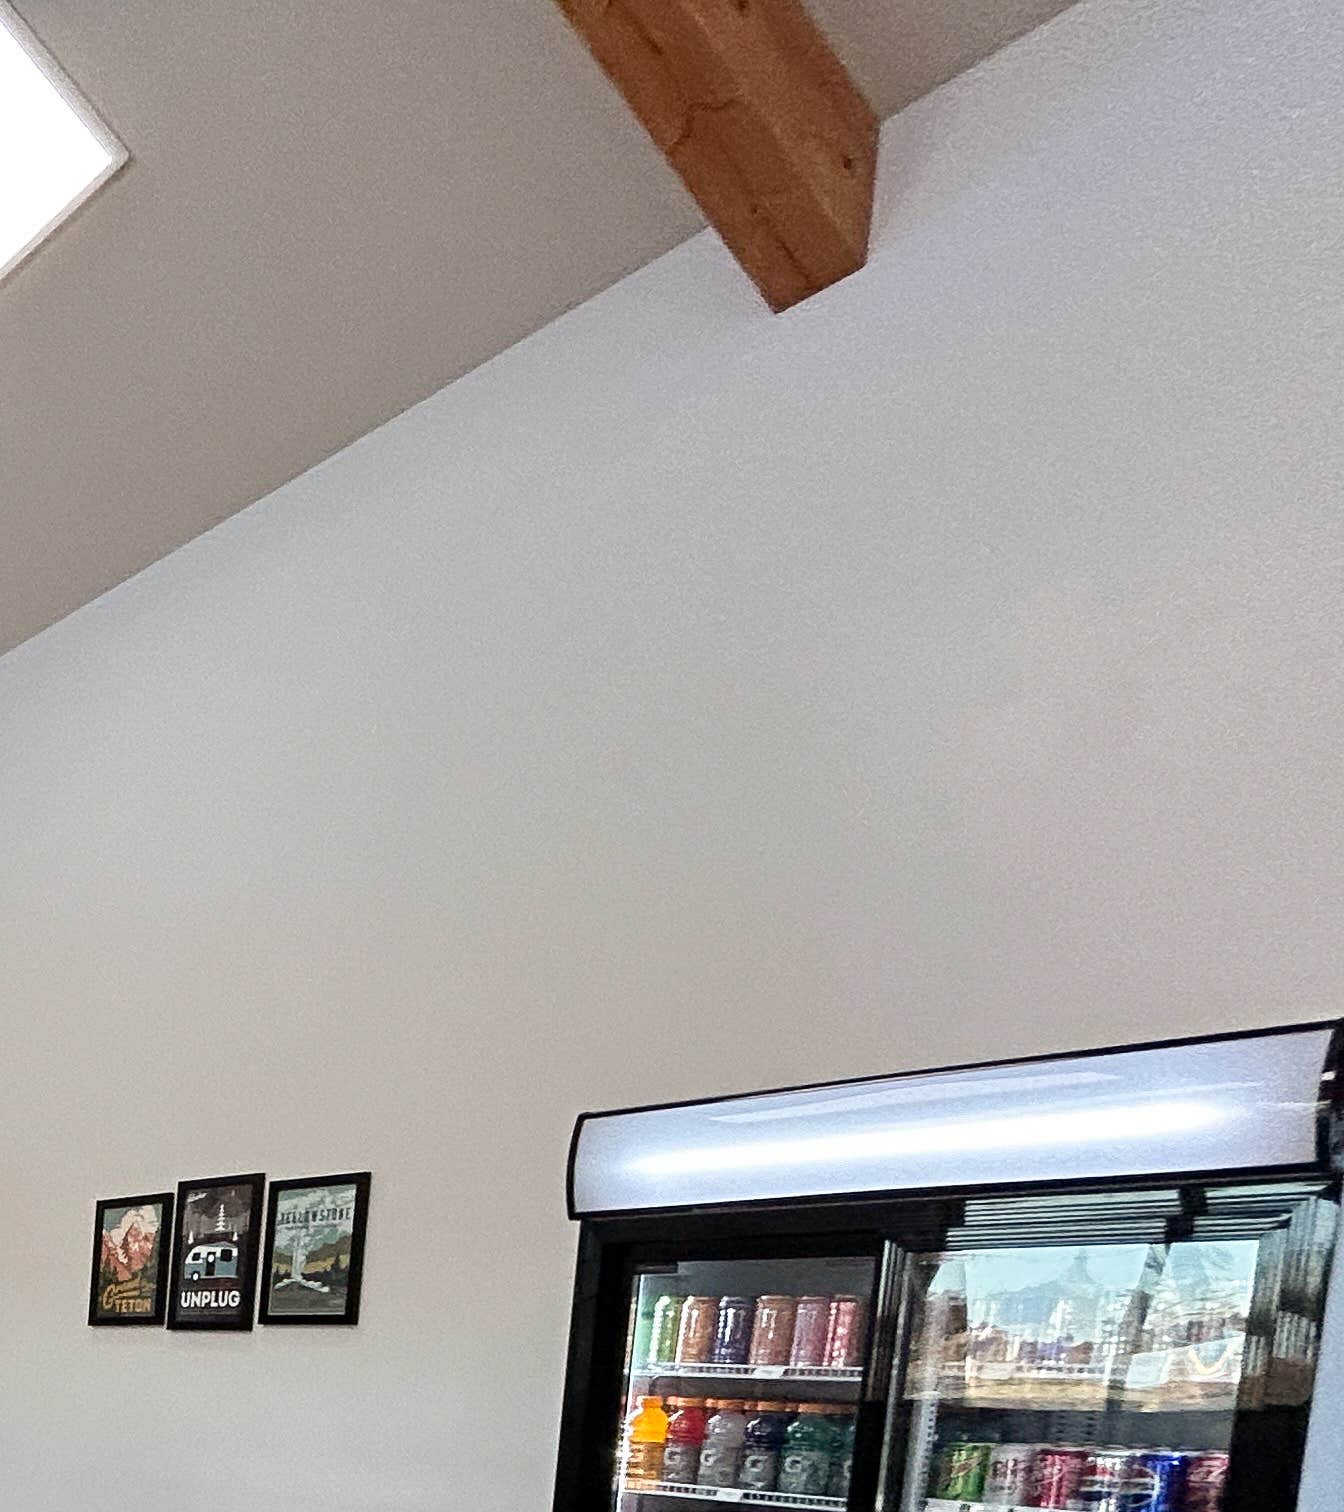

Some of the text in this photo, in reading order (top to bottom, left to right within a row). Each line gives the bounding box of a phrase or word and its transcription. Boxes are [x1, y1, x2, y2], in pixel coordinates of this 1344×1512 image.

[278, 1208, 352, 1226] YELLOWSTONE
[115, 1298, 152, 1312] TETON
[180, 1290, 241, 1308] UNPLUG
